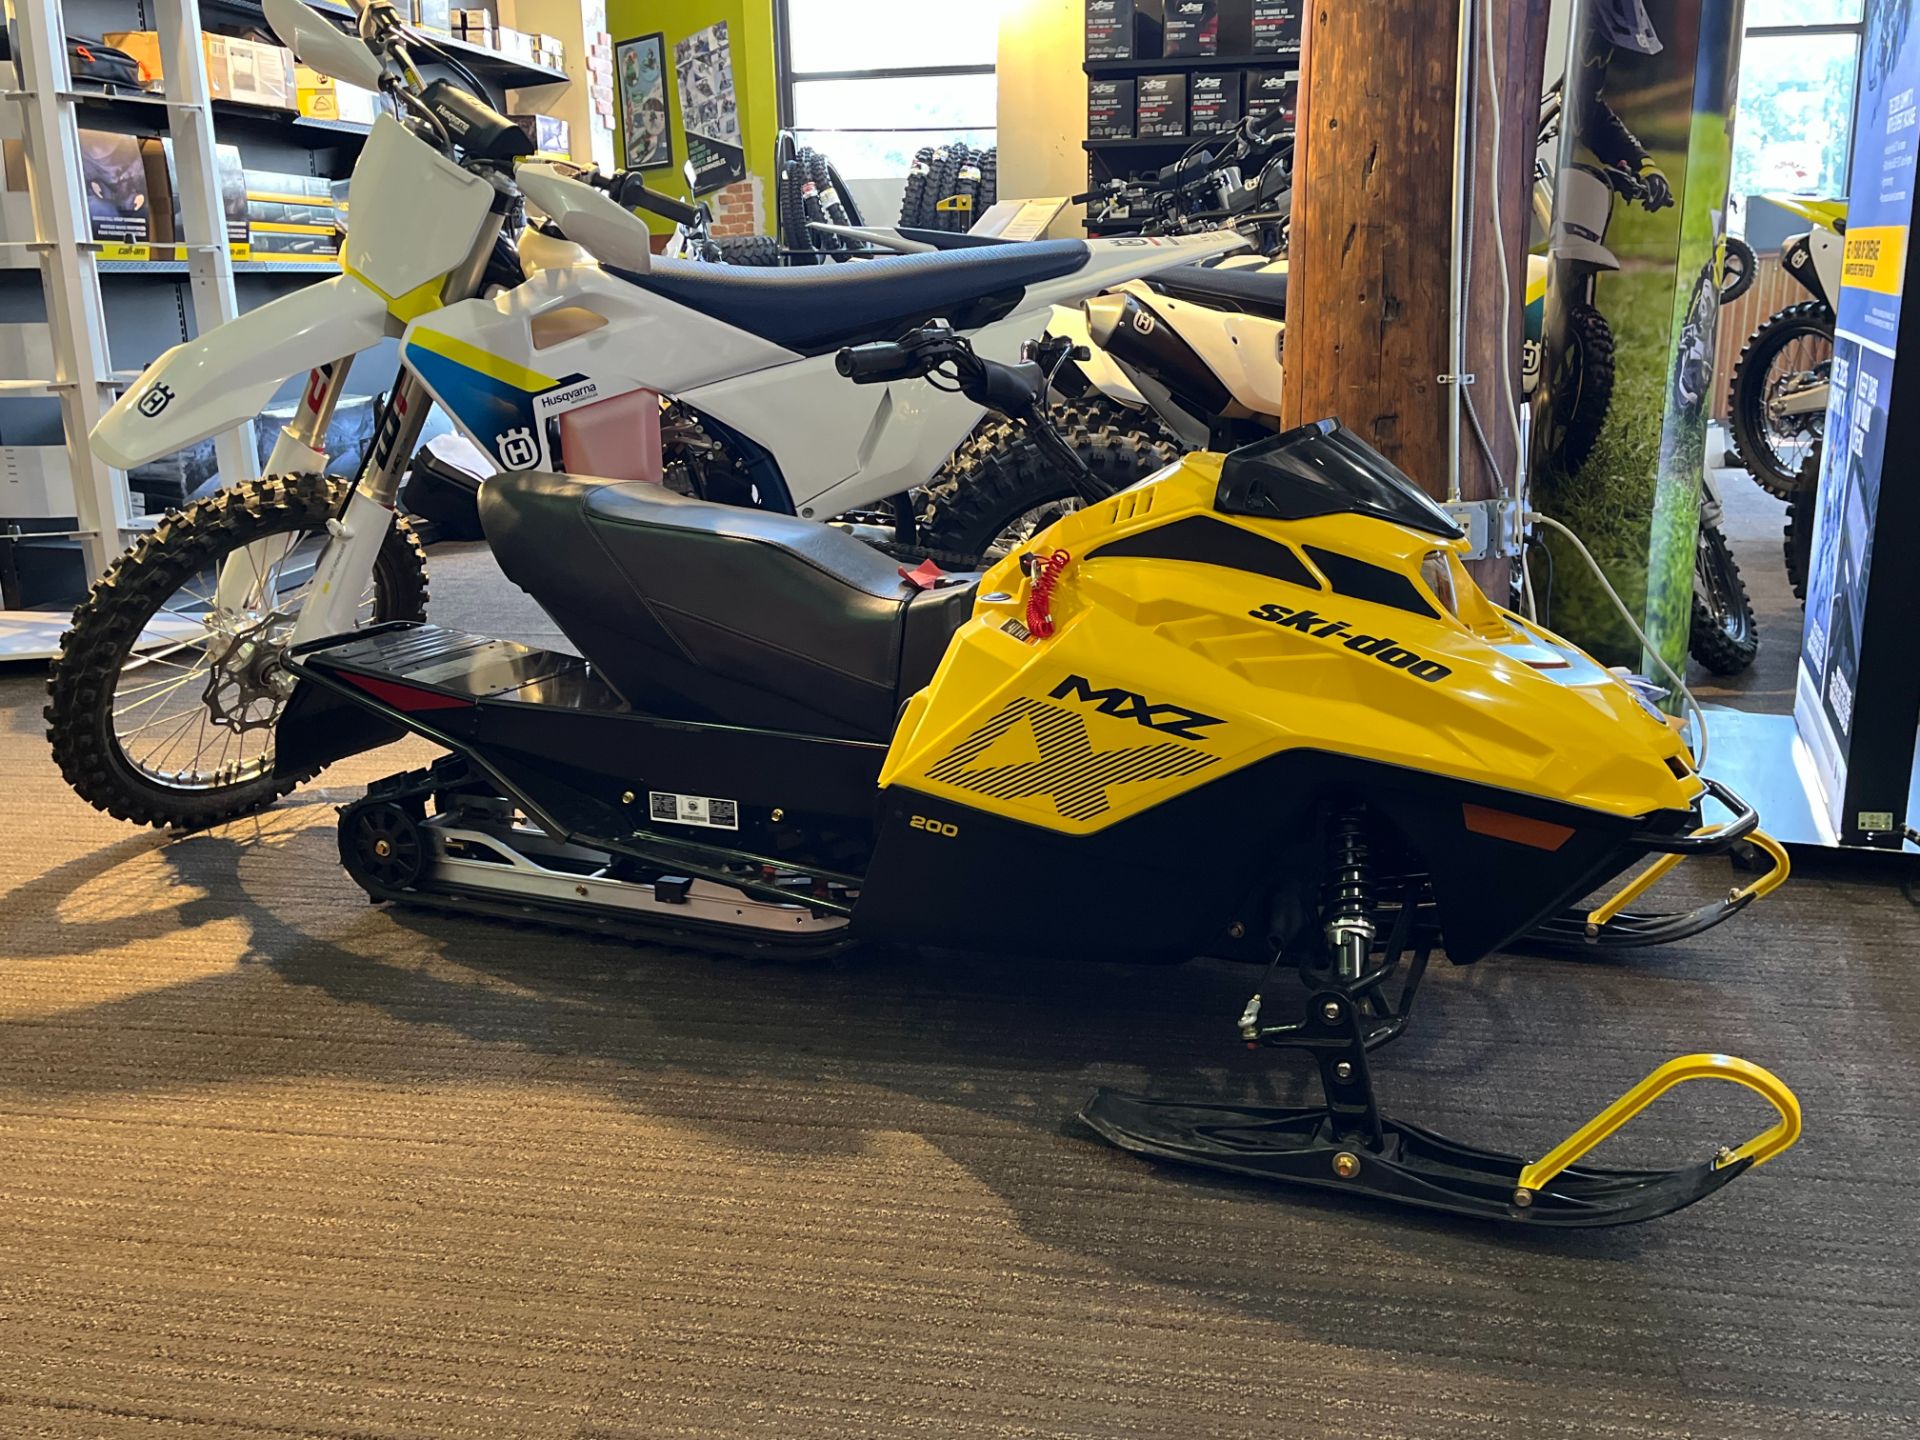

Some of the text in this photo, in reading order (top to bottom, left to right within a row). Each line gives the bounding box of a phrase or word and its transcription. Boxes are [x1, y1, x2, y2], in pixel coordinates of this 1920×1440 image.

[1195, 77, 1222, 88] XPS
[541, 383, 597, 408] Husqvarna
[1248, 604, 1453, 682] ski-doo
[1047, 674, 1229, 741] MXZ
[909, 815, 959, 837] 200
